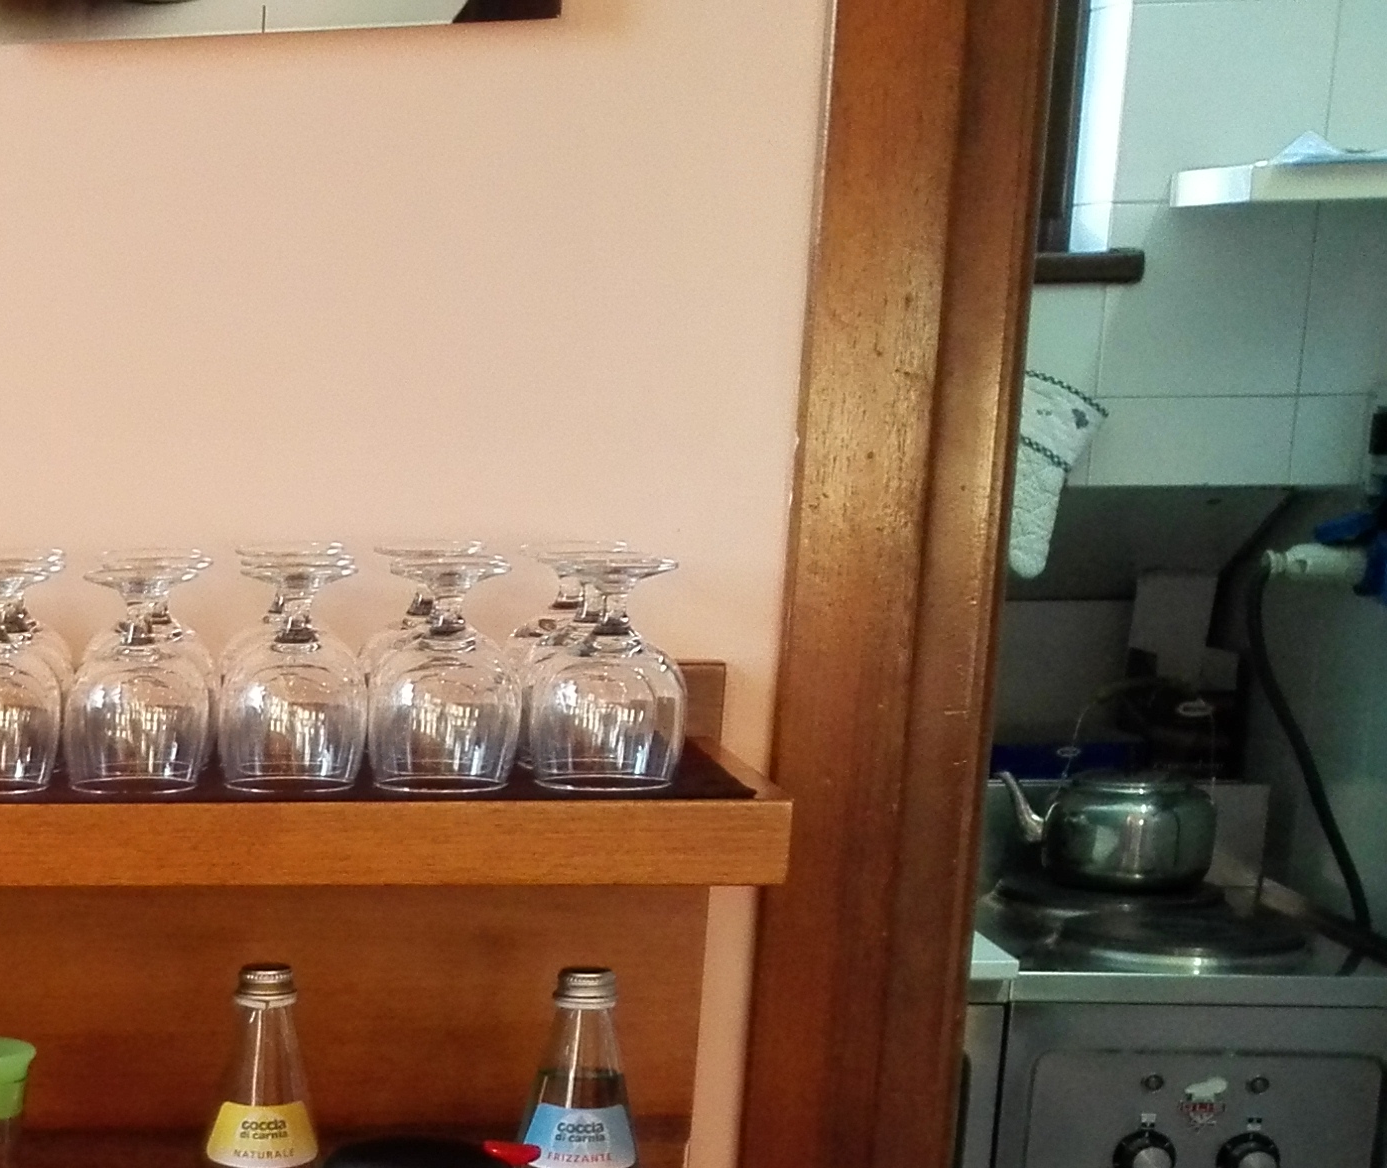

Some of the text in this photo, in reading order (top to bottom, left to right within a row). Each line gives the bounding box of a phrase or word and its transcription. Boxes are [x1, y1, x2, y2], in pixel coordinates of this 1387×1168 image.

[252, 1130, 288, 1140] carnia
[568, 1133, 606, 1143] carnia
[233, 1148, 295, 1160] NATURALE
[547, 1151, 613, 1163] FRIZZANTE
